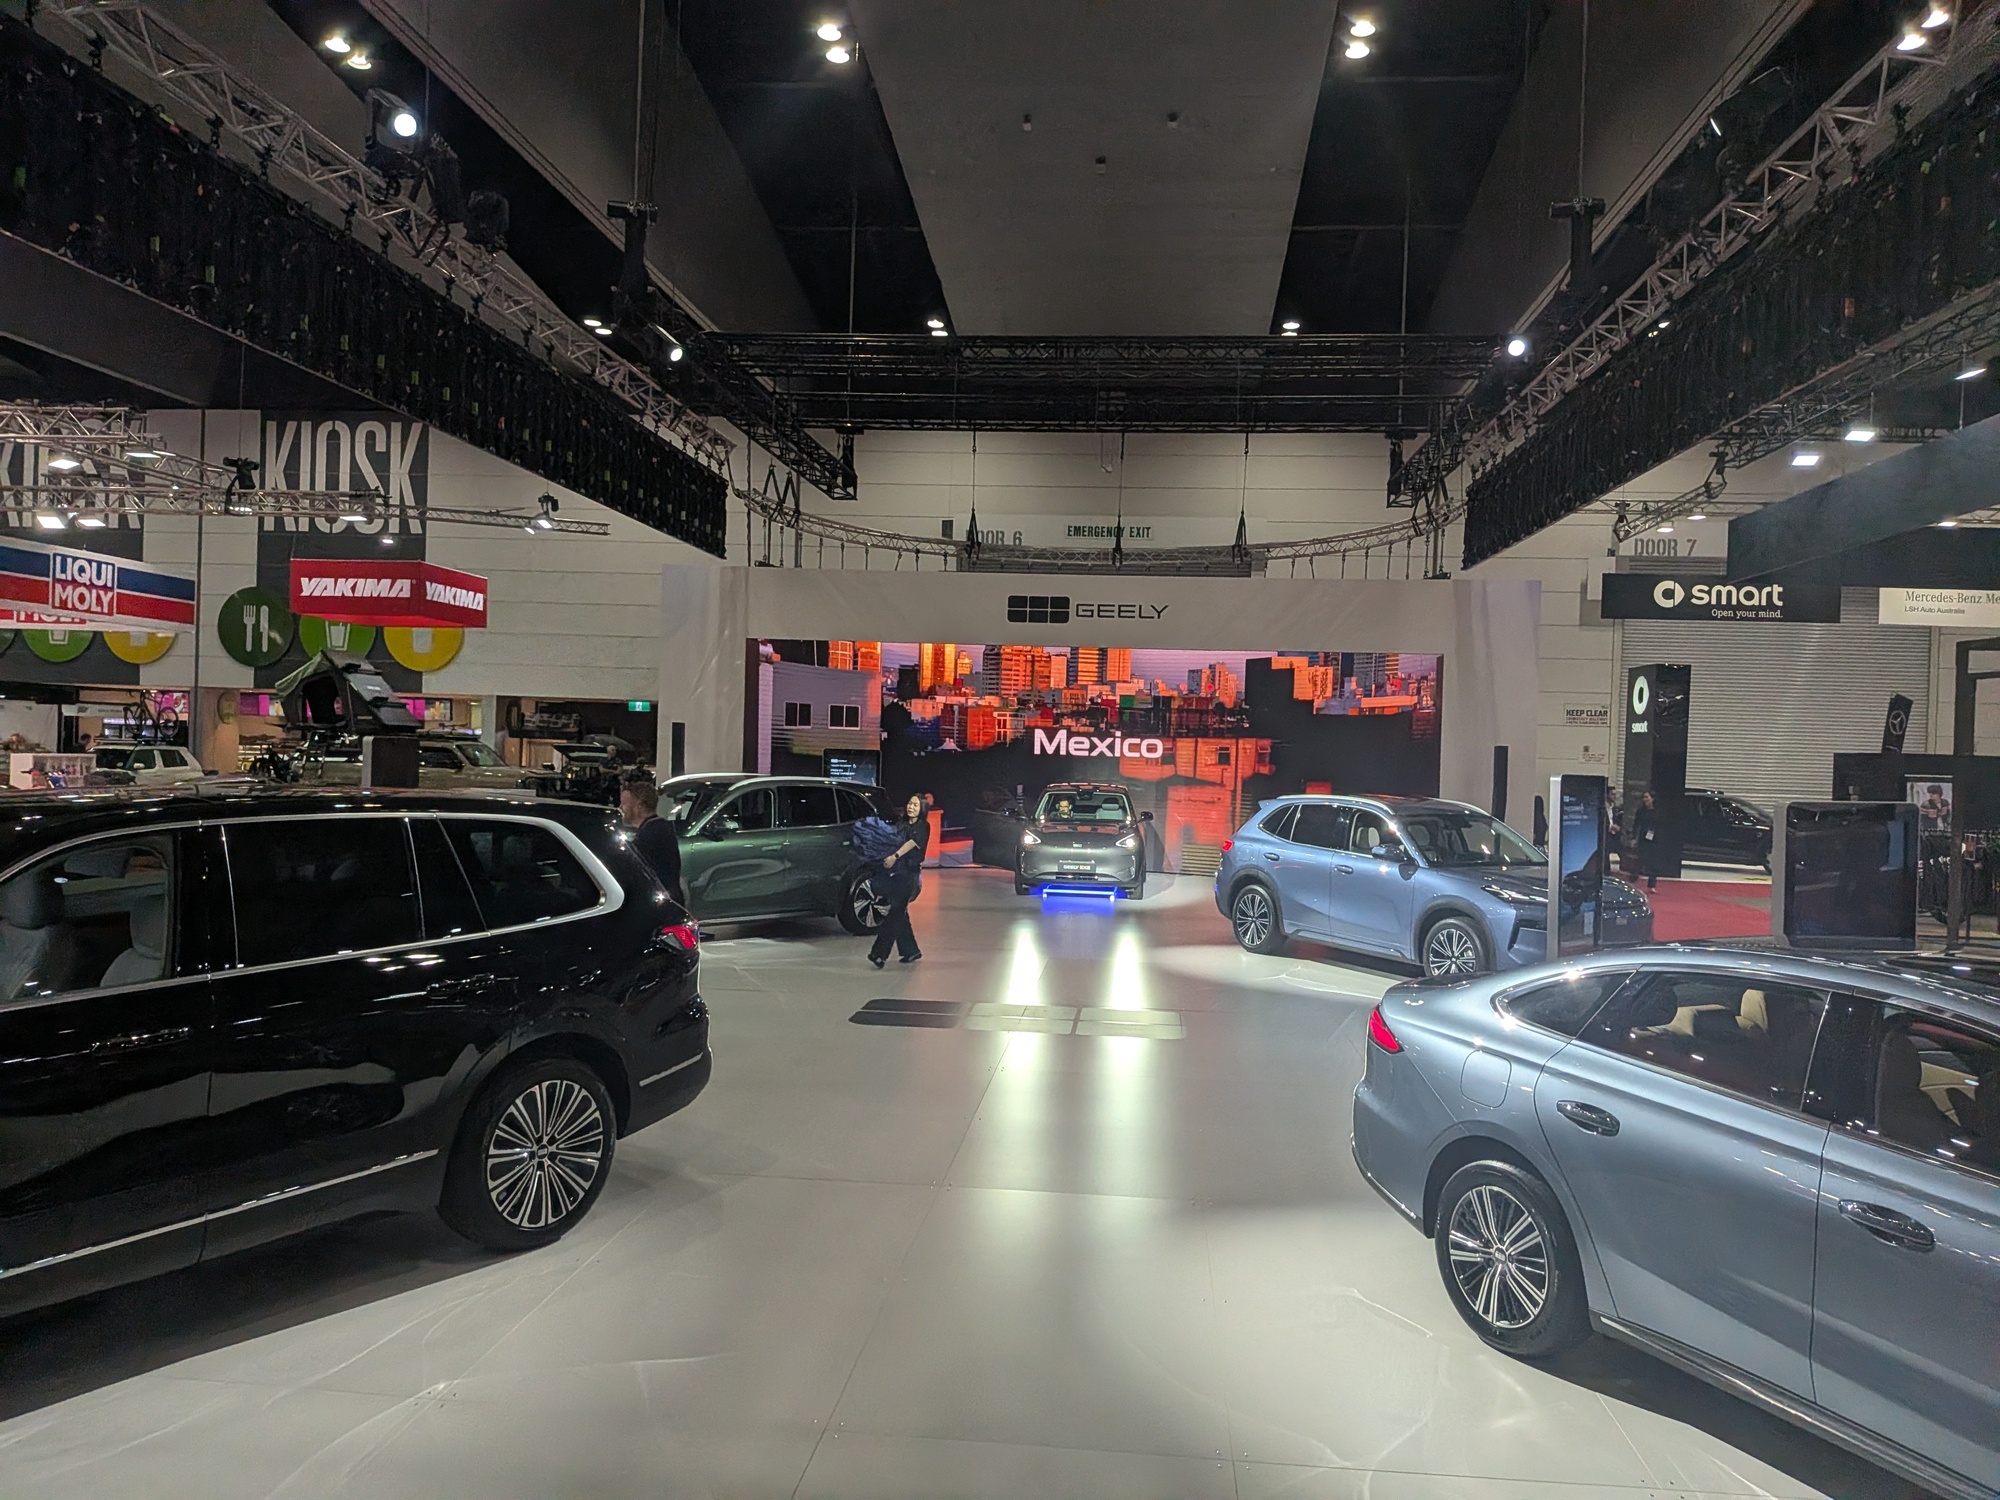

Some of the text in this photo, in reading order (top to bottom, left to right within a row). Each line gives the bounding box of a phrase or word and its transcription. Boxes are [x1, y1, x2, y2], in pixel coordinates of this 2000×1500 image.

[264, 420, 423, 534] KIOSK
[1012, 530, 1023, 546] 6
[1129, 526, 1151, 538] EXIT
[1634, 538, 1697, 556] DOOR 7
[55, 555, 114, 588] LIQUI
[300, 577, 411, 598] YAKIMA
[425, 581, 484, 611] YAKIMA
[1690, 584, 1784, 607] smart
[1905, 591, 1983, 603] Mercedes-Benz
[54, 585, 114, 613] MOLY
[1075, 603, 1169, 620] GEELY
[1711, 608, 1784, 619] Open your mind.
[1566, 709, 1609, 717] KEEP CLEAR
[1034, 728, 1164, 758] Mexico
